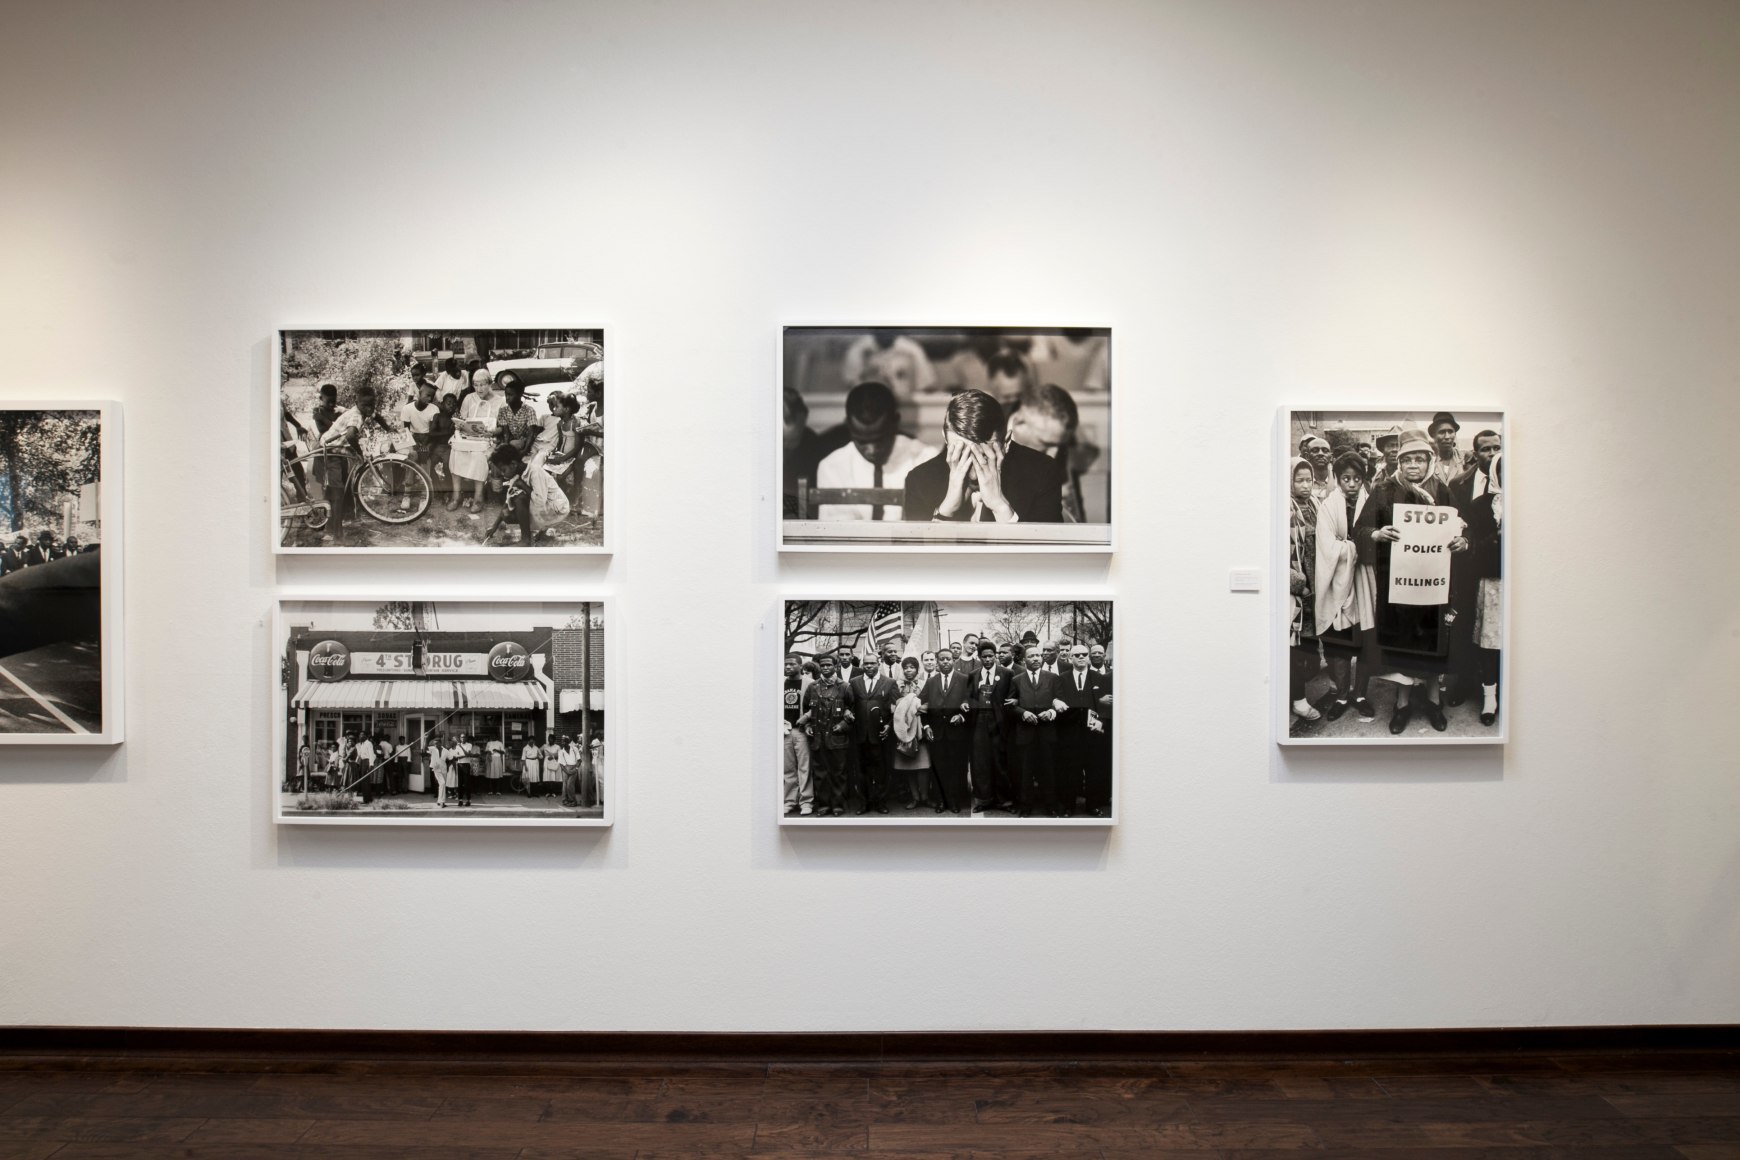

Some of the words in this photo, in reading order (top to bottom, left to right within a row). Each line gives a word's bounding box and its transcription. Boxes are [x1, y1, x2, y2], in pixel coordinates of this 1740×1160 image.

[1403, 510, 1449, 525] STOP
[1403, 544, 1443, 553] POLICE
[1394, 577, 1446, 587] KILLINGS
[393, 654, 413, 668] ST
